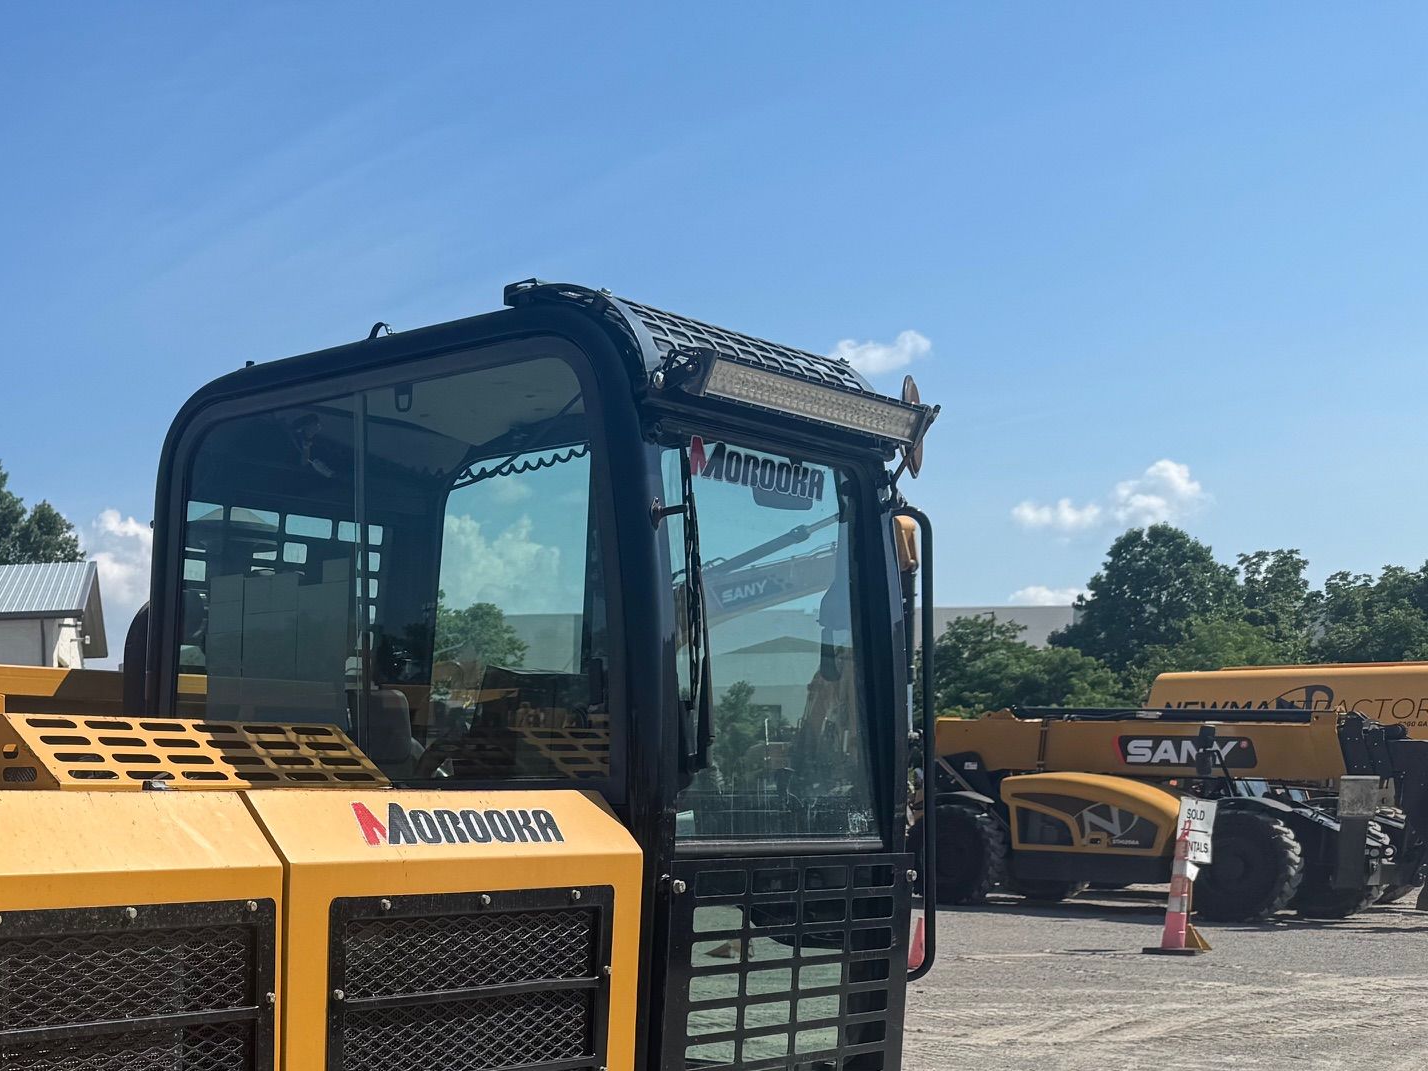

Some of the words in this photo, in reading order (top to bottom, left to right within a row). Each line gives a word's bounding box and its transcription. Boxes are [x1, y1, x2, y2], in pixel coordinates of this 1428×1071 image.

[689, 434, 825, 501] MOROOKA
[721, 579, 768, 604] SANY
[350, 801, 566, 846] MOROOKA
[1186, 808, 1205, 821] SOLD
[1187, 841, 1209, 853] NTALS
